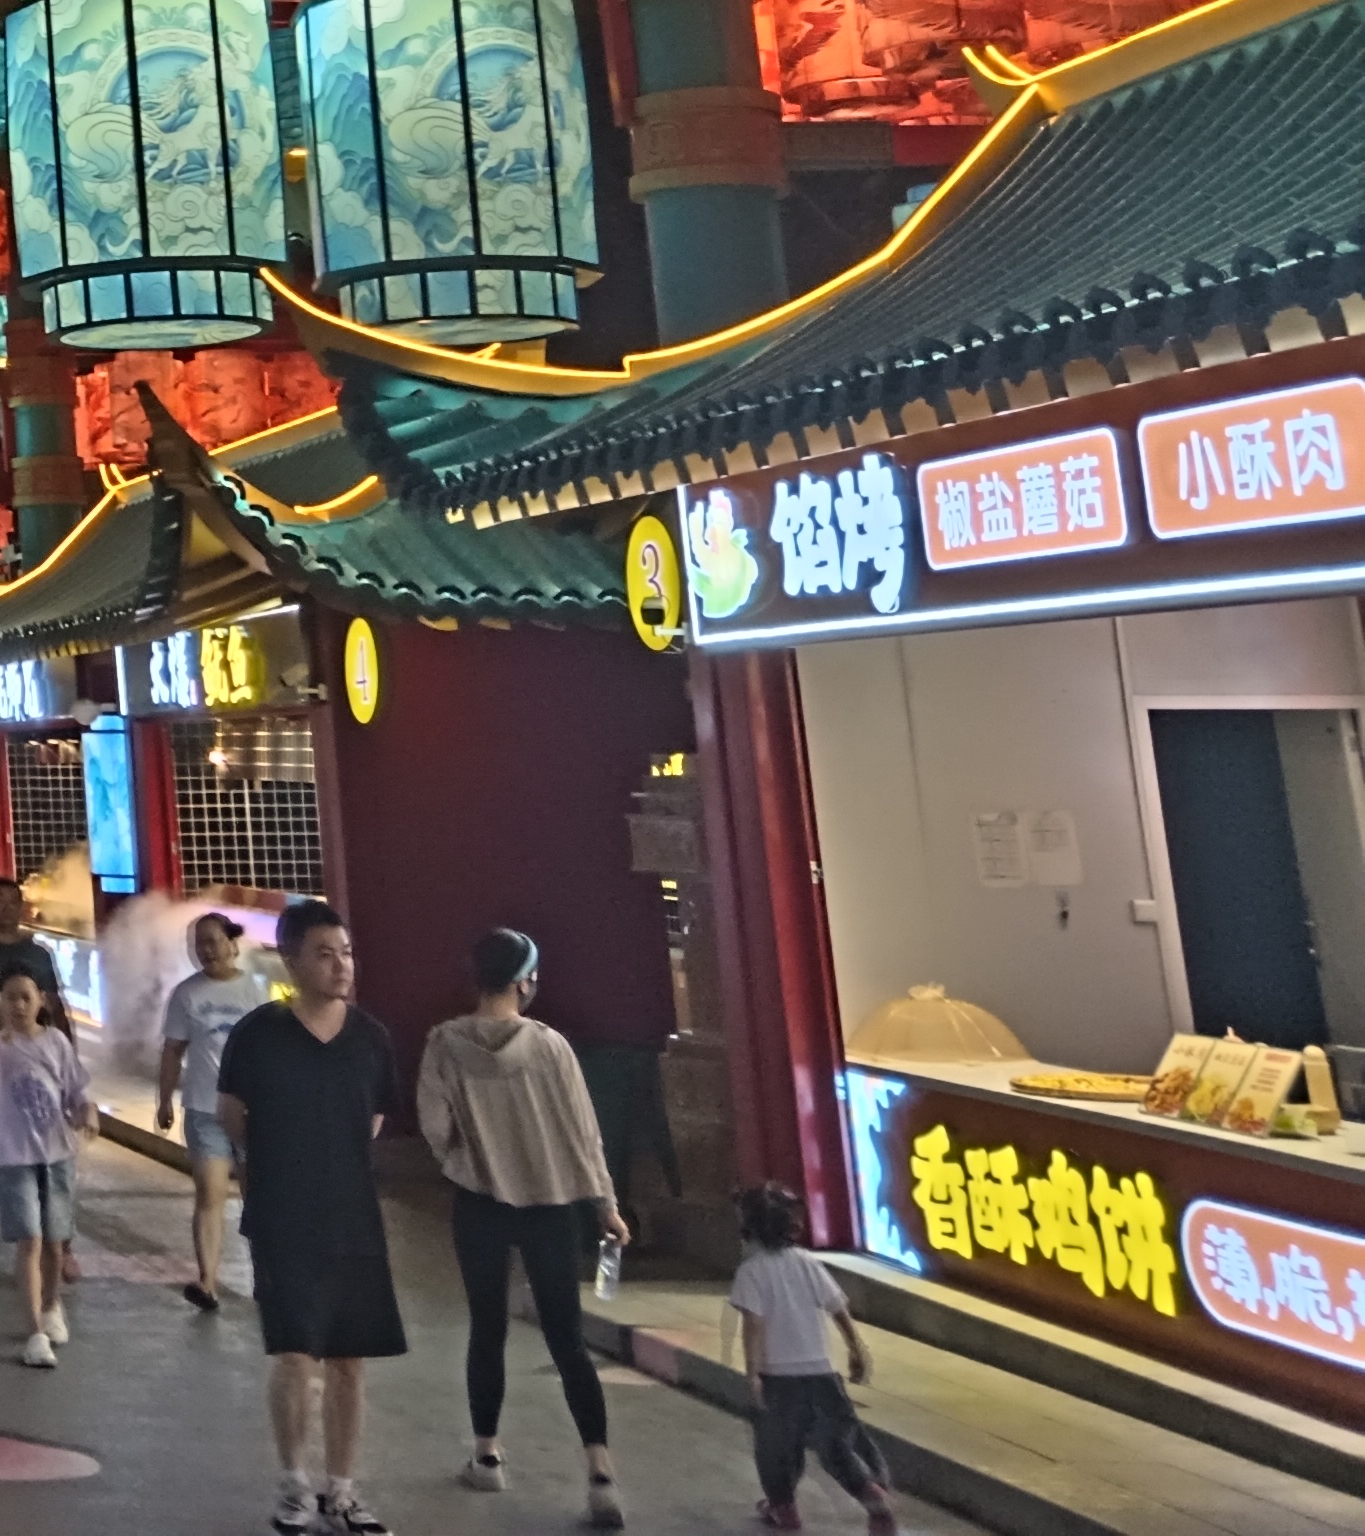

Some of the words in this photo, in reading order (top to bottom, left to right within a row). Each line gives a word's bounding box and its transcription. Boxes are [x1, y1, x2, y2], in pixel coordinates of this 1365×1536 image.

[935, 453, 1105, 551] 椒盐蘑菇
[1178, 408, 1345, 510] 小酥肉
[641, 543, 664, 610] 3
[770, 452, 905, 614] 馅烤
[354, 638, 369, 704] 4
[910, 1124, 1177, 1317] 香酥鸡饼
[1201, 1224, 1365, 1343] 薄,脆,
